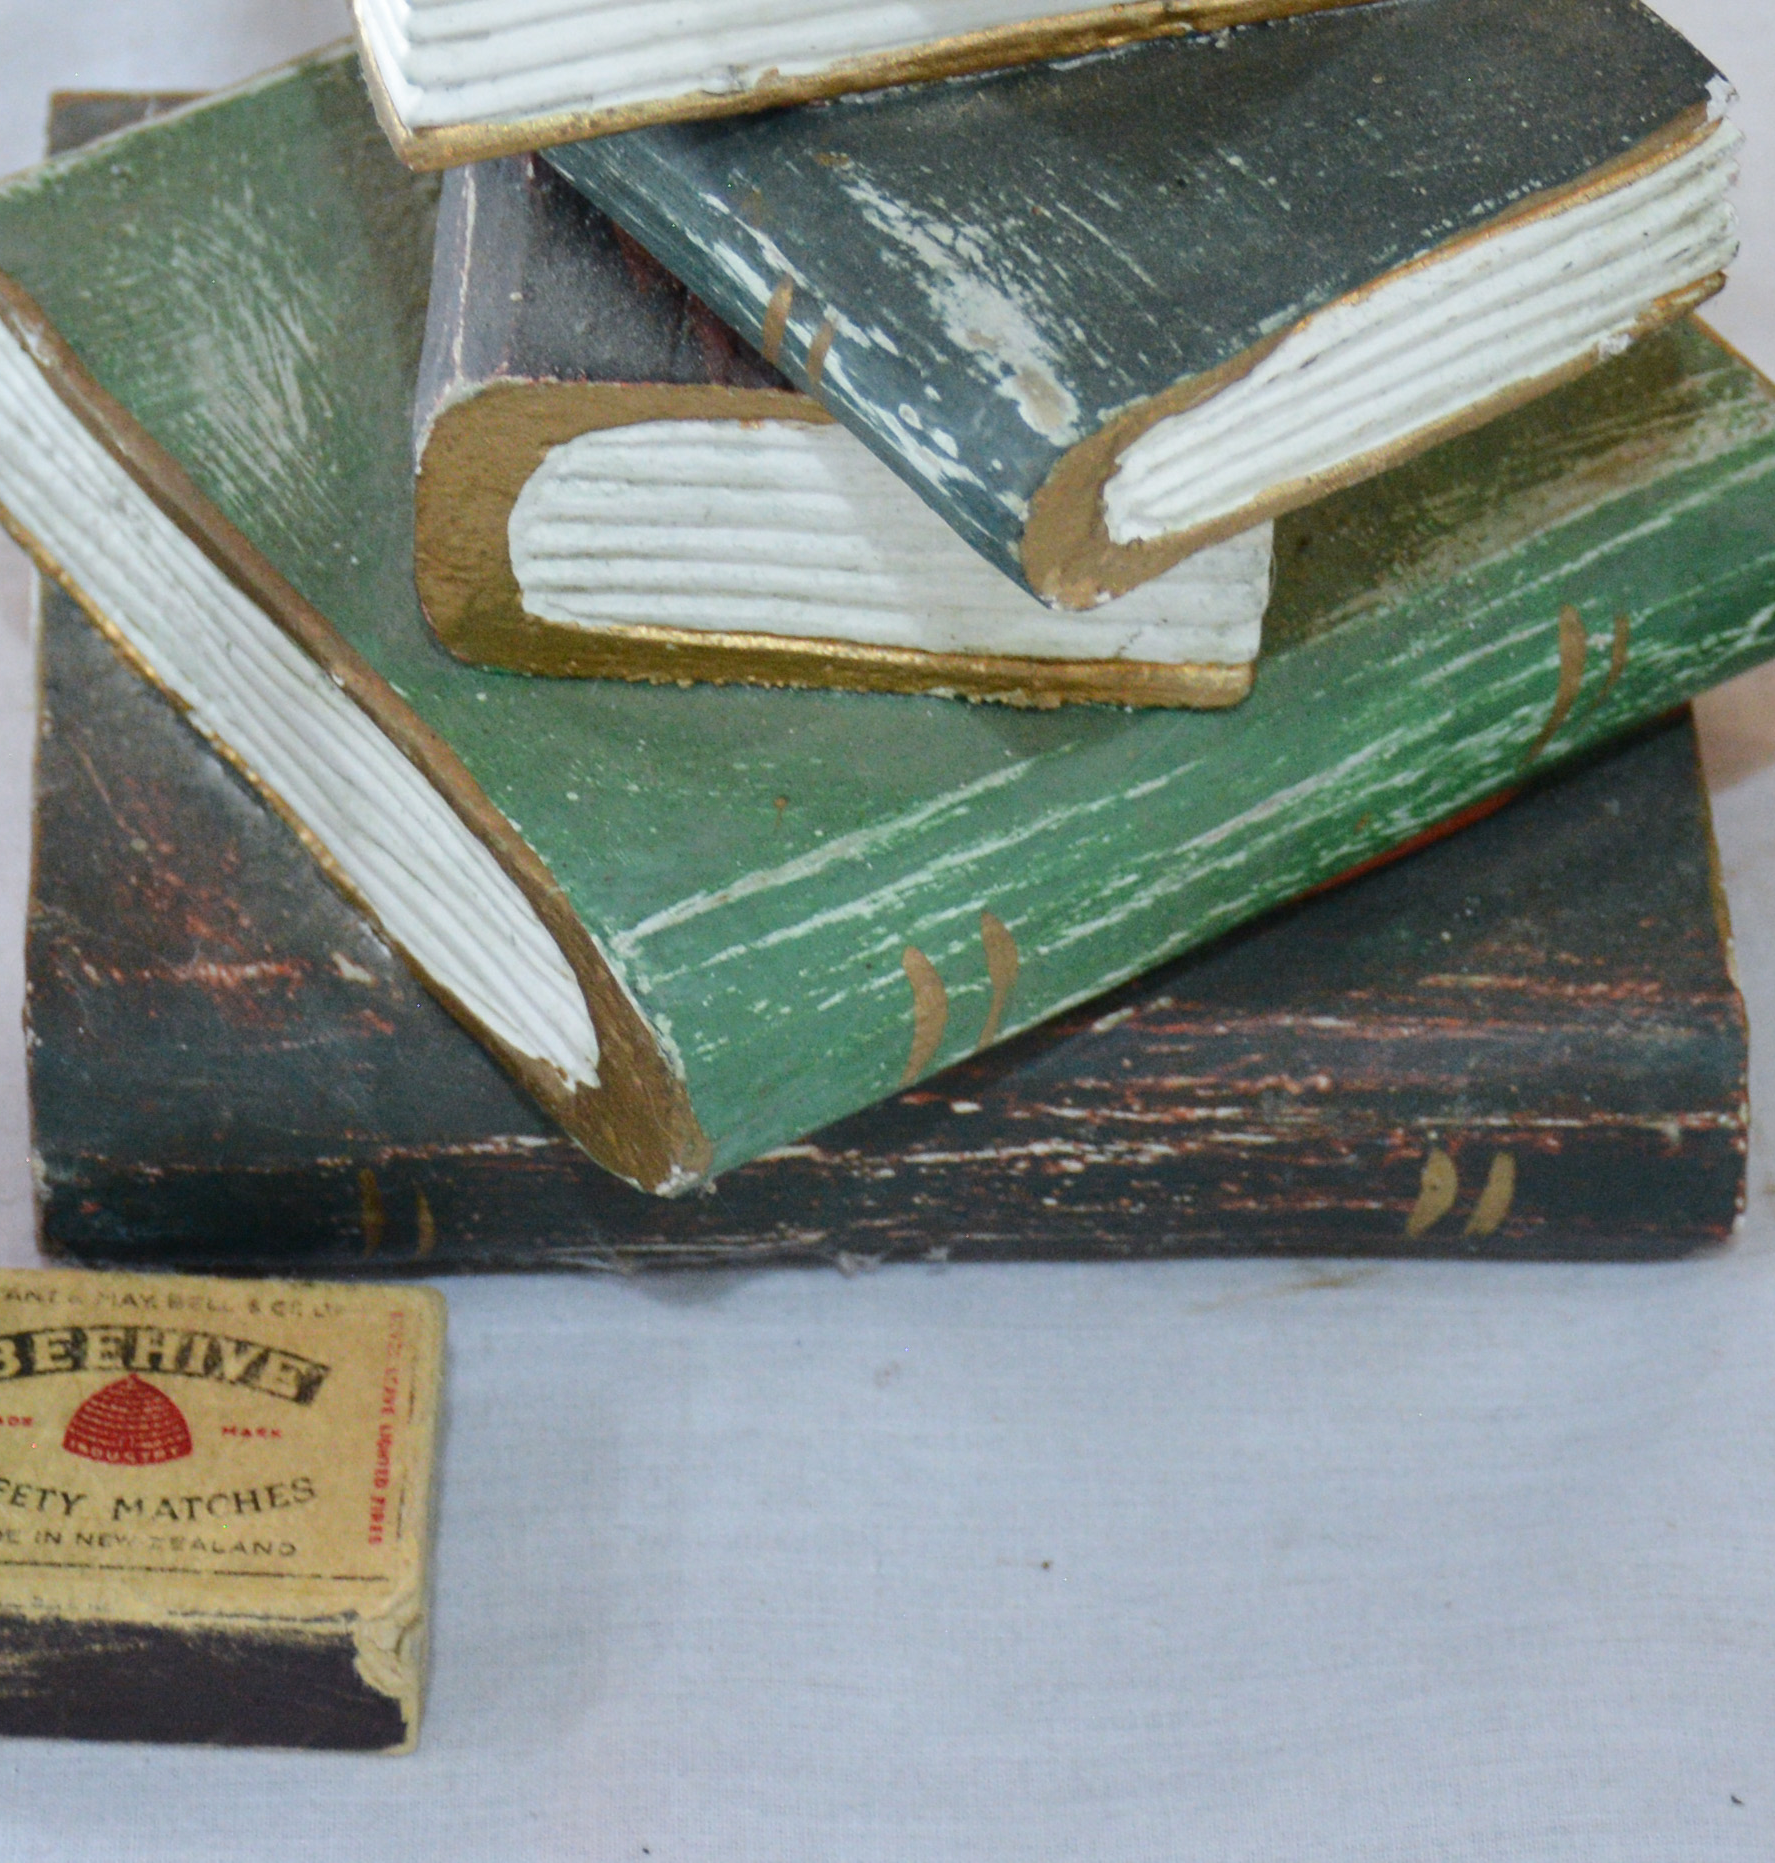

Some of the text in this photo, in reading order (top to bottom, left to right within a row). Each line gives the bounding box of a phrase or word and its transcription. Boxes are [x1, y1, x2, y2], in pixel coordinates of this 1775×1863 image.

[221, 1424, 283, 1439] MARK
[111, 1475, 318, 1523] MATCHES
[34, 1529, 63, 1546] IN
[148, 1535, 298, 1558] ZEALAND
